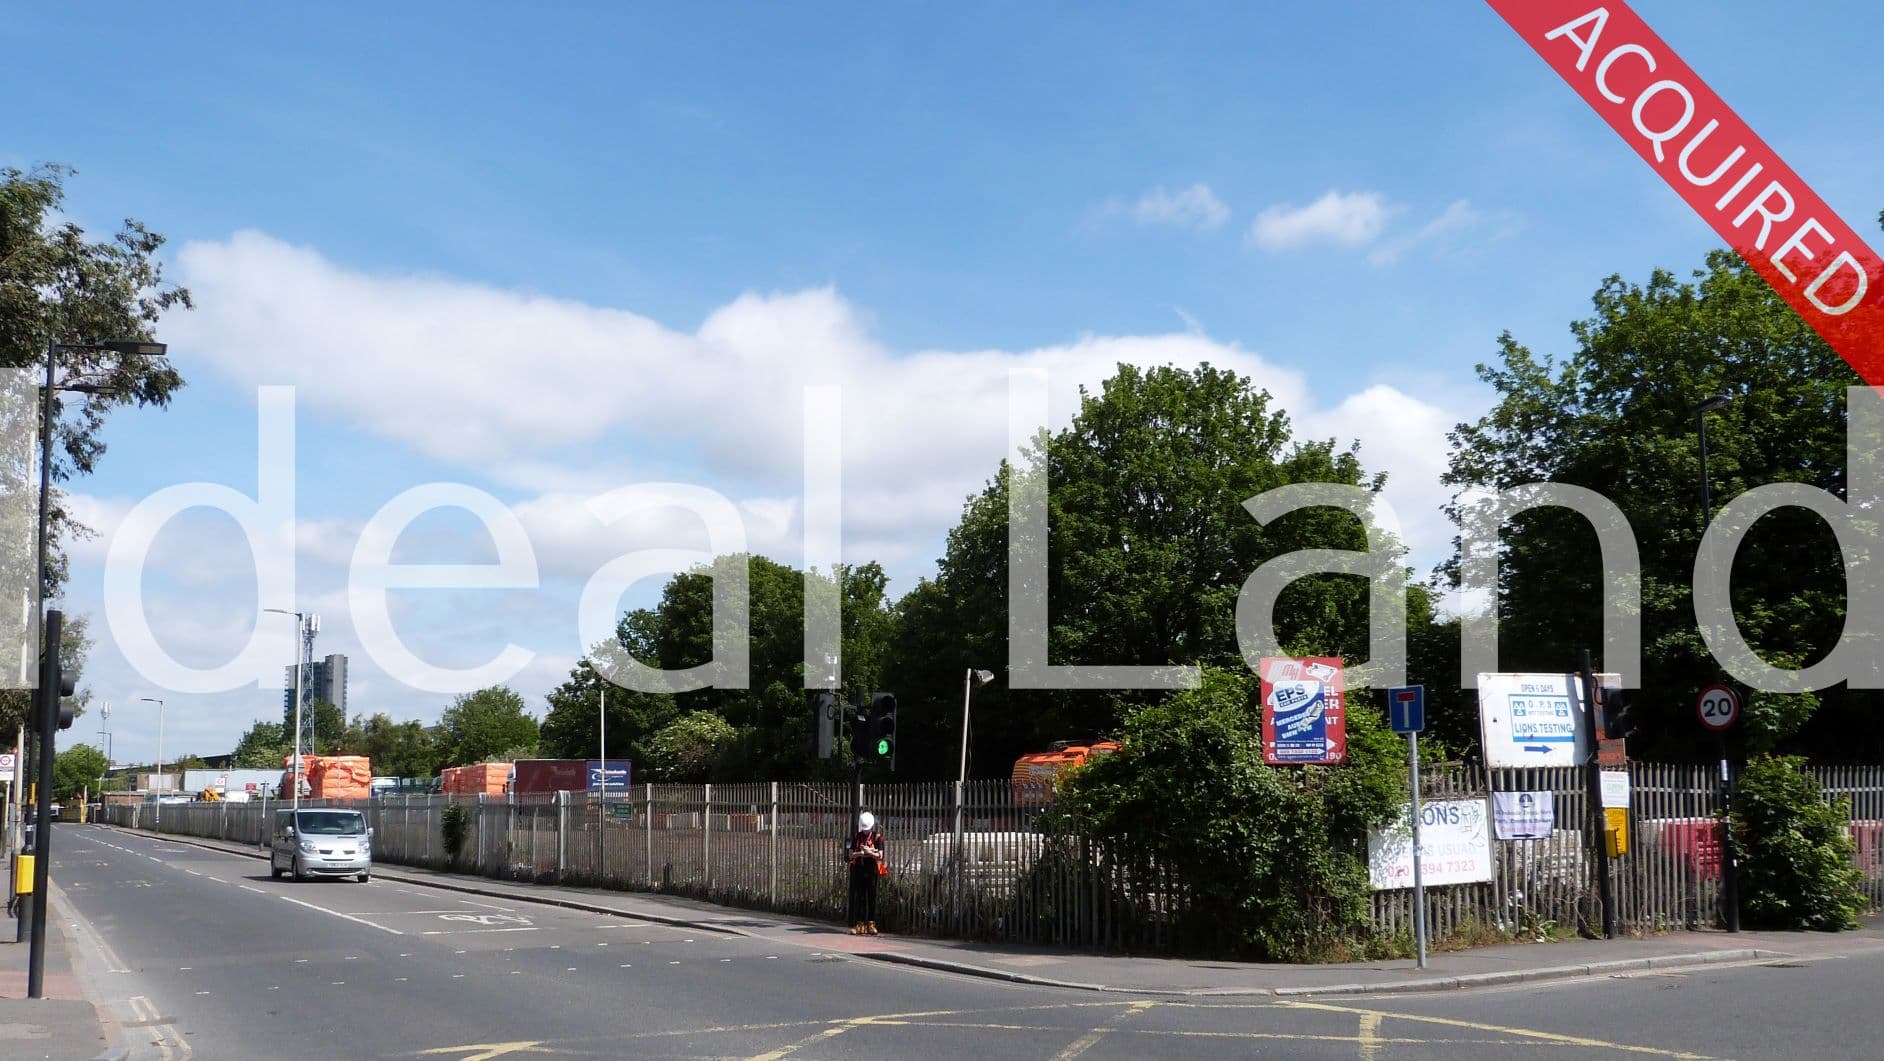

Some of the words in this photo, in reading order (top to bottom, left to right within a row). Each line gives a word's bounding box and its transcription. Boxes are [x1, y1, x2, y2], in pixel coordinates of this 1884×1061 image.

[1275, 683, 1306, 702] EPS
[1703, 698, 1731, 717] 20
[1514, 723, 1537, 734] LIONS
[1539, 723, 1574, 733] TESTING
[1421, 805, 1460, 827] ONS
[1447, 860, 1476, 874] 7323
